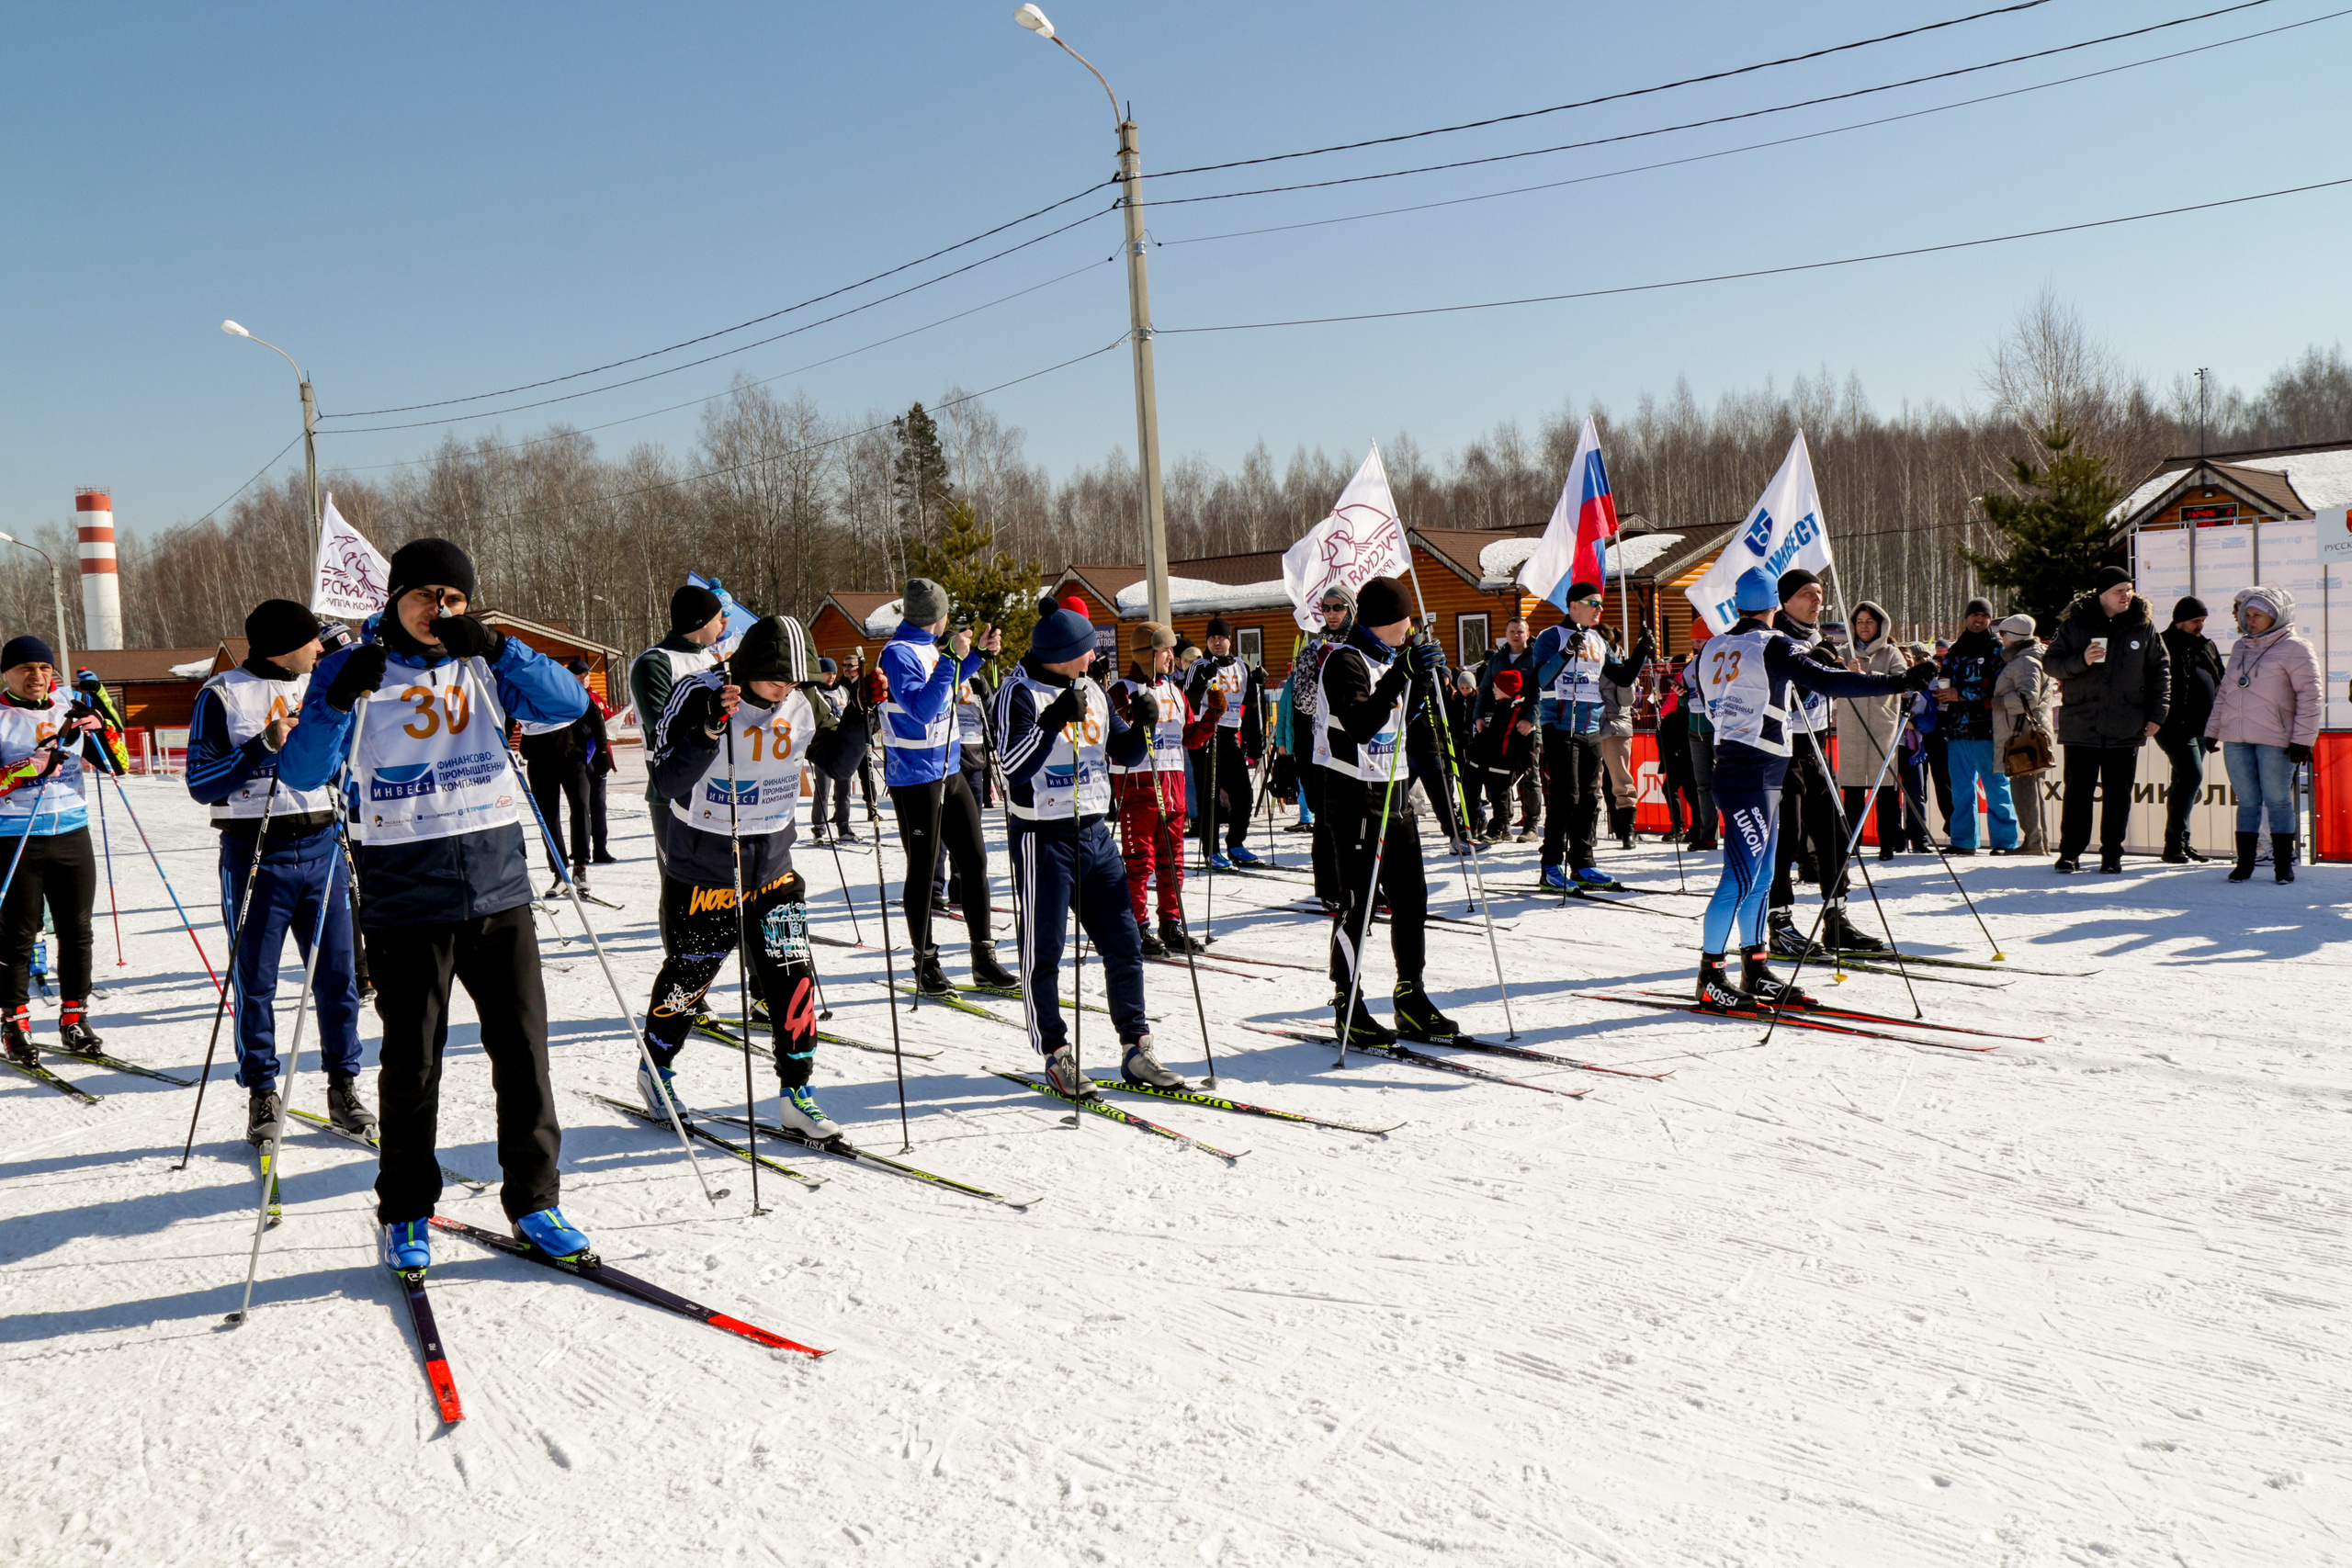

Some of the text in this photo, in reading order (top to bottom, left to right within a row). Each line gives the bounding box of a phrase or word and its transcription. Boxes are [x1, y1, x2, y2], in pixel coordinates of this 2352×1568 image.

[1764, 512, 1820, 579] ИНВЕСТ
[1713, 650, 1741, 684] 23
[401, 685, 469, 739] 30
[743, 717, 791, 761] 18
[436, 751, 495, 771] ФИНАНСОВО-
[373, 782, 432, 798] ИНВЕСТ
[441, 774, 492, 793] КОМПАНИЯ
[762, 792, 794, 805] КОМПАНИЯ
[1733, 808, 1762, 857] LUKOIL
[785, 949, 809, 958] STRE
[1430, 1036, 1453, 1044] ATOMIC
[803, 1138, 826, 1152] TISA
[556, 1259, 580, 1273] ATOMIC
